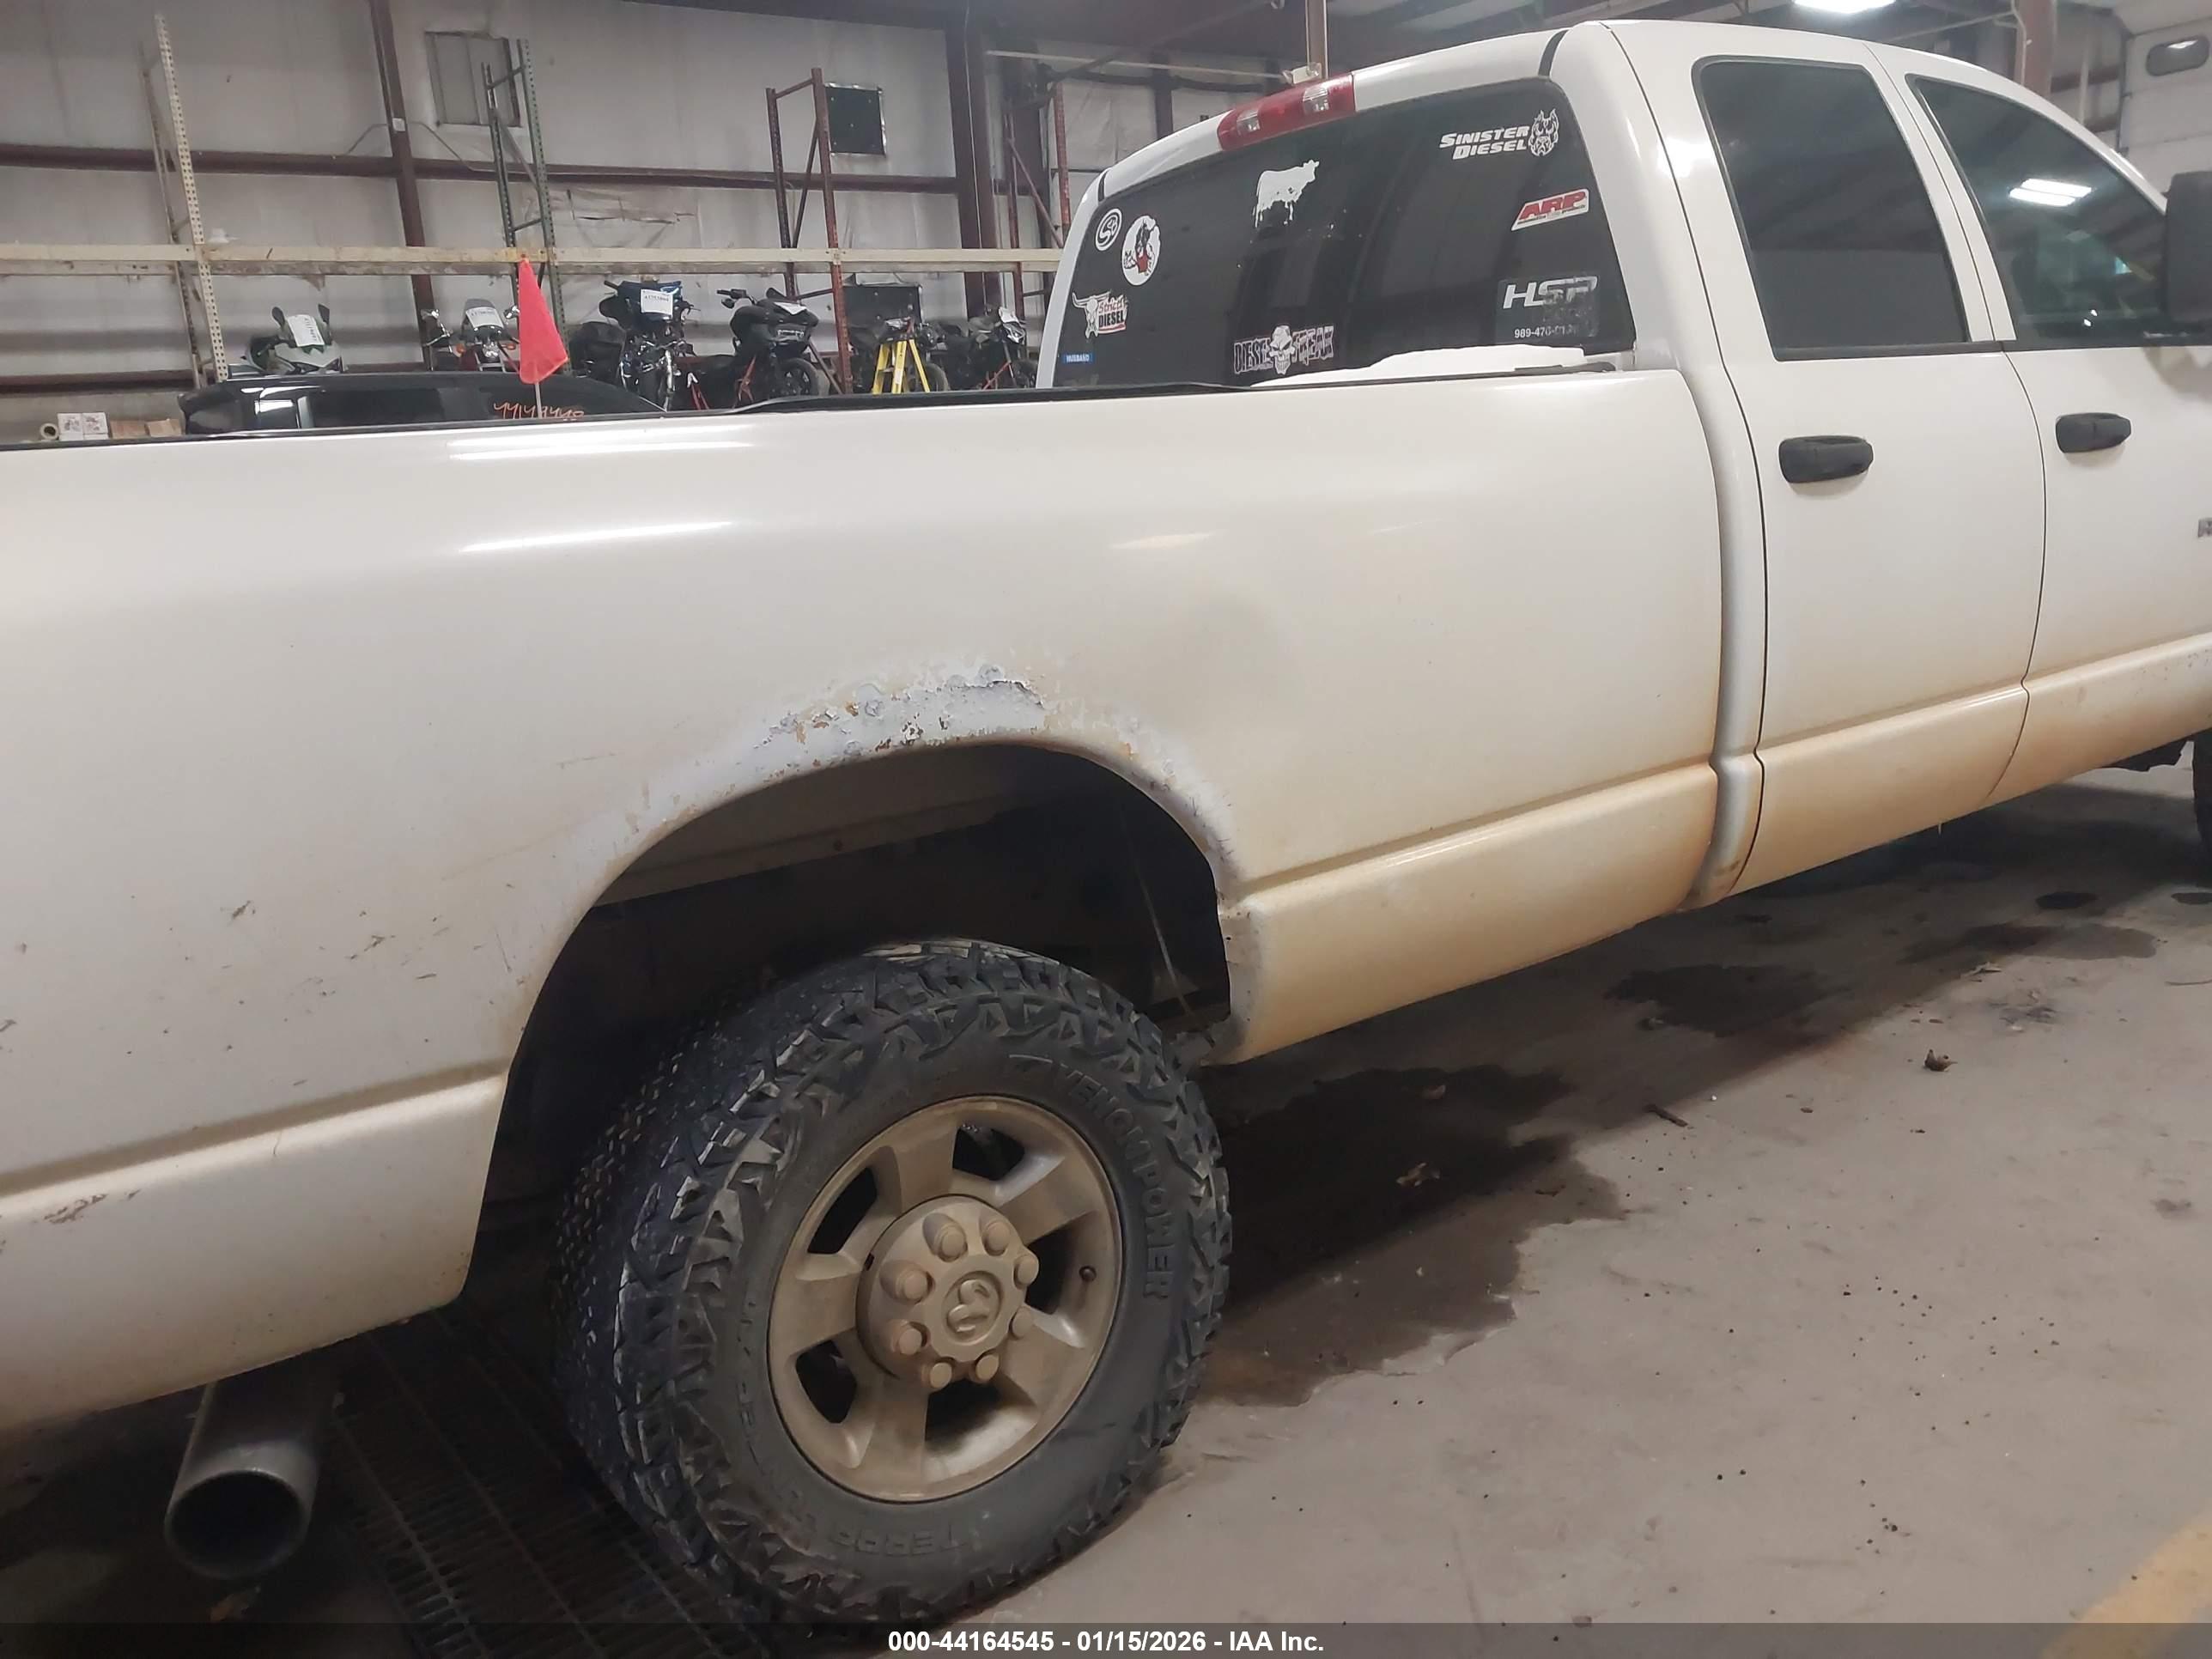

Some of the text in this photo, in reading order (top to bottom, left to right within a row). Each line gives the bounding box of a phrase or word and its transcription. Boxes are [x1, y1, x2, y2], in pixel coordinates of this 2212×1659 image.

[1439, 125, 1530, 149] SINISTER
[1453, 139, 1527, 160] DIESEL
[1518, 191, 1587, 221] ARP
[1098, 310, 1124, 328] DIESEL
[1234, 325, 1334, 374] DIESEL FREAK
[1133, 1160, 1176, 1298] POWER
